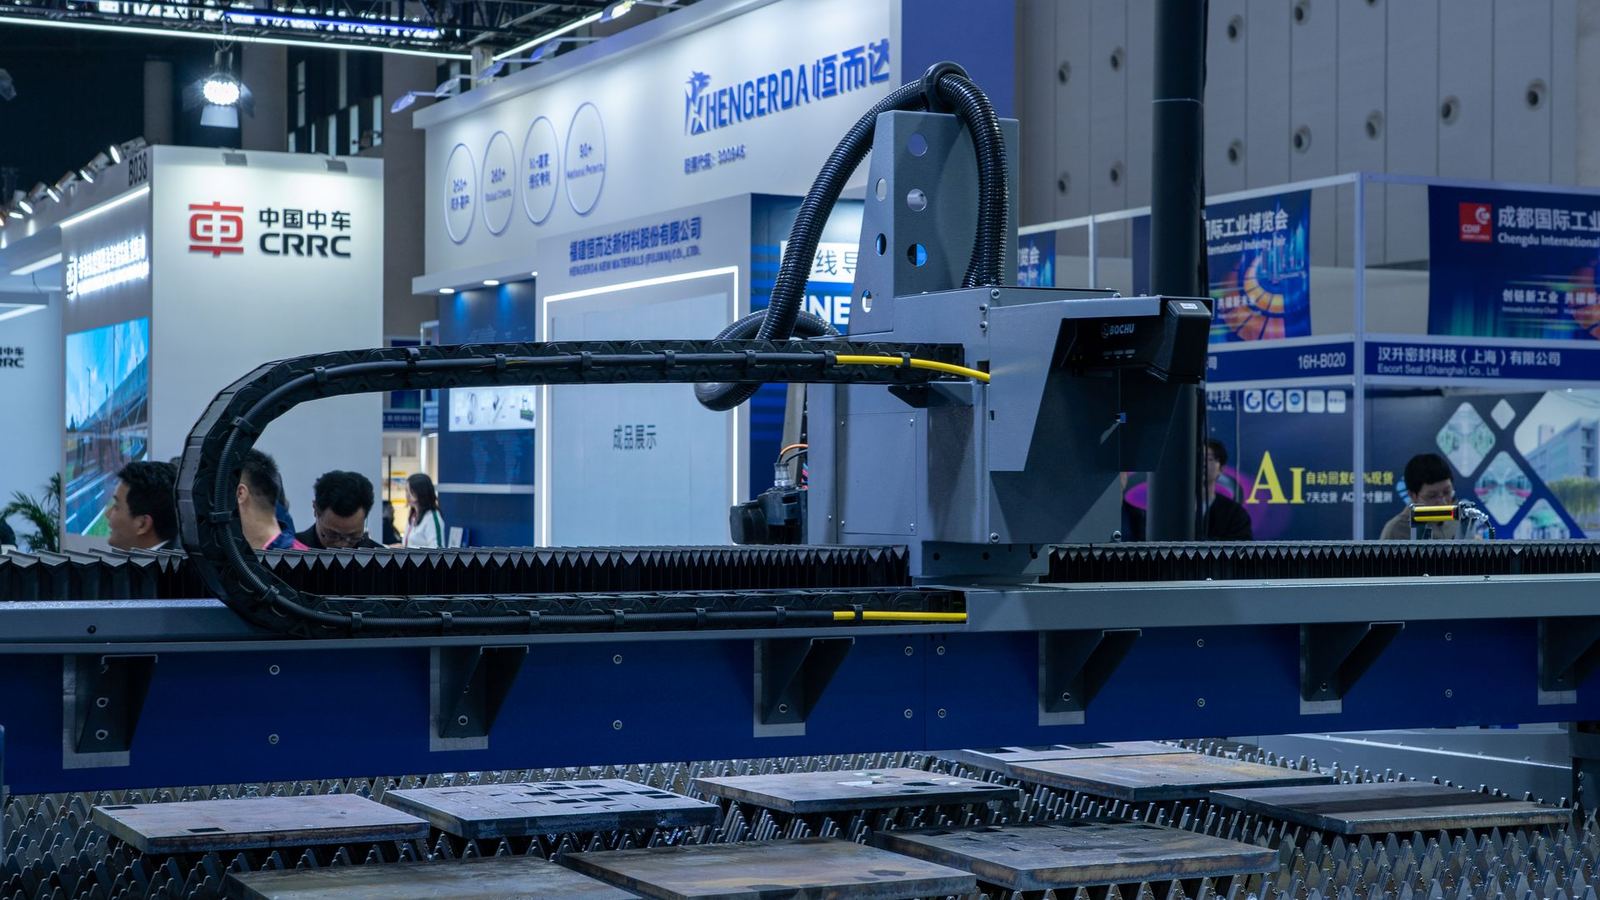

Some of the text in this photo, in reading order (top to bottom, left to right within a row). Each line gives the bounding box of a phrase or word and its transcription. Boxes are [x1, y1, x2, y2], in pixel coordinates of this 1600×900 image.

[812, 38, 890, 100] 恒而达
[705, 63, 809, 132] HENGERDA
[128, 151, 148, 186] B038
[259, 207, 351, 231] 中国中车
[1498, 205, 1600, 232] 成都国际工业
[259, 232, 351, 258] CRRC
[1498, 232, 1539, 248] Chengdu
[1541, 235, 1600, 248] International
[1109, 323, 1135, 336] BOCHU
[0, 346, 24, 356] 中车
[1298, 352, 1346, 370] 16H-B020
[1377, 363, 1401, 374] Escort
[1405, 365, 1423, 375] Seal
[1424, 365, 1467, 377] (Shanghai)
[613, 424, 657, 450] 成品展示
[1247, 451, 1305, 504] AI
